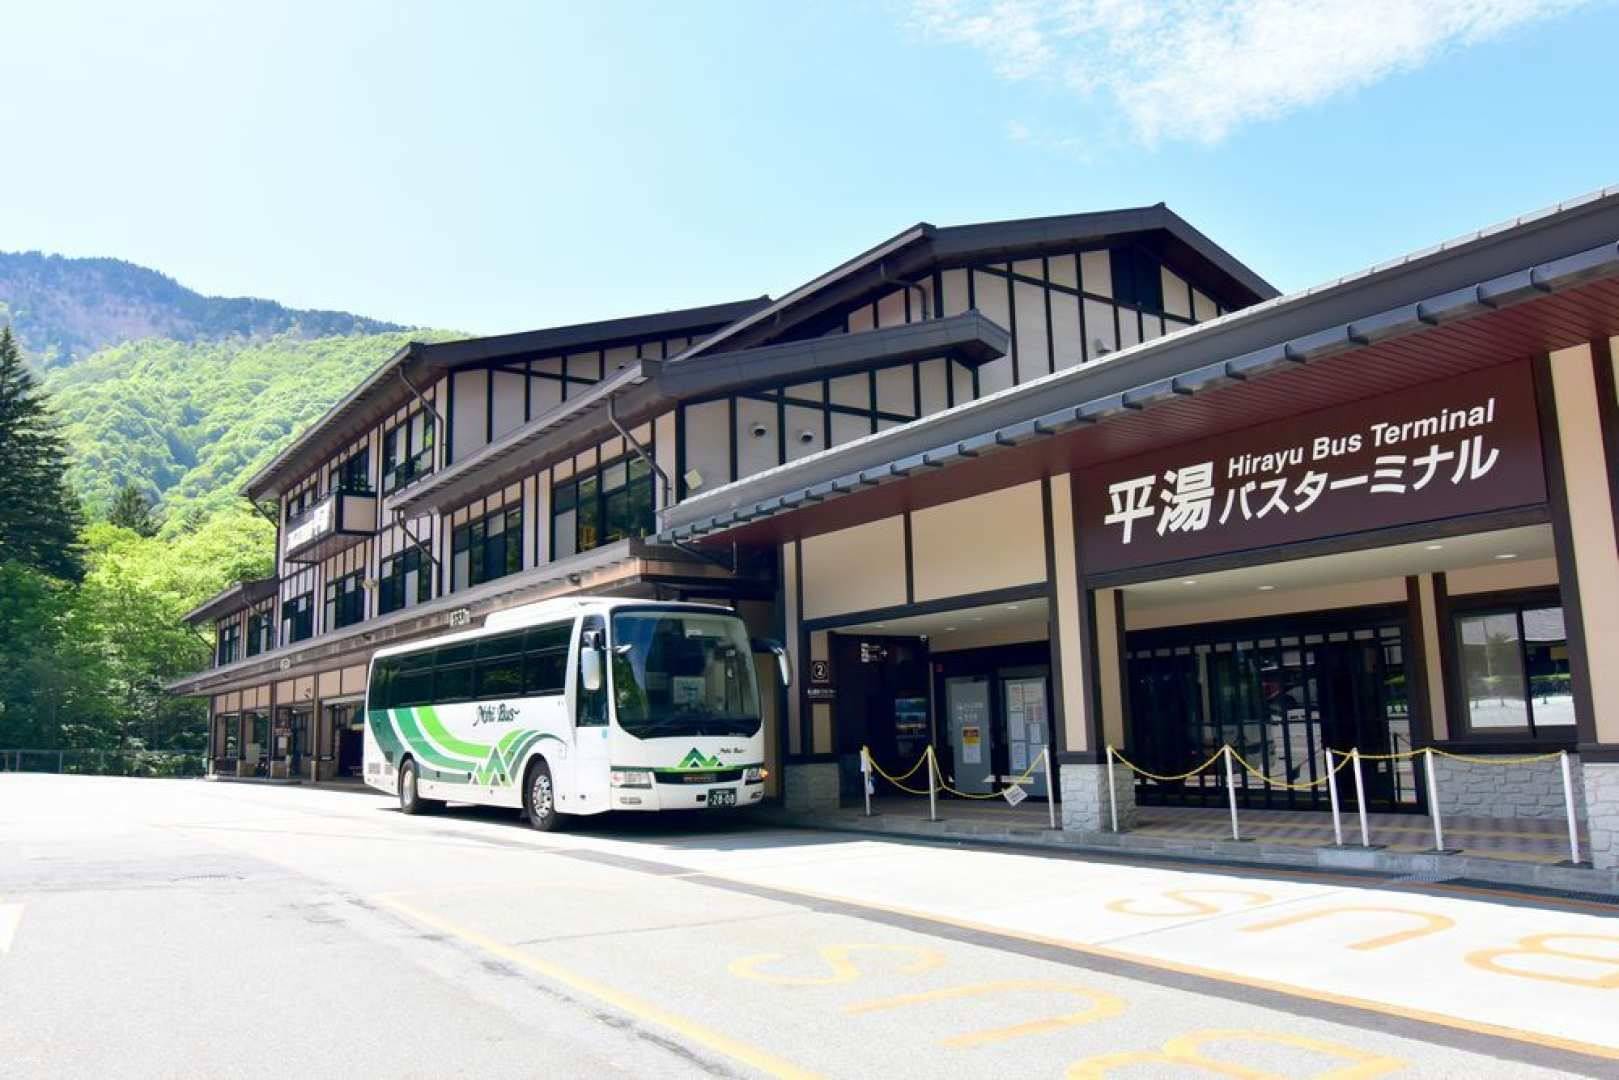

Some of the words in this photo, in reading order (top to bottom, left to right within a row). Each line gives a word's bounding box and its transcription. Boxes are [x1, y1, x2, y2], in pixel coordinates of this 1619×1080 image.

[1218, 434, 1500, 525] バスターミナル
[1228, 446, 1304, 479] Hirayu
[1312, 435, 1363, 461] Bus
[1371, 397, 1496, 448] Terminal
[1104, 461, 1215, 545] 平湯
[497, 703, 521, 722] Bus
